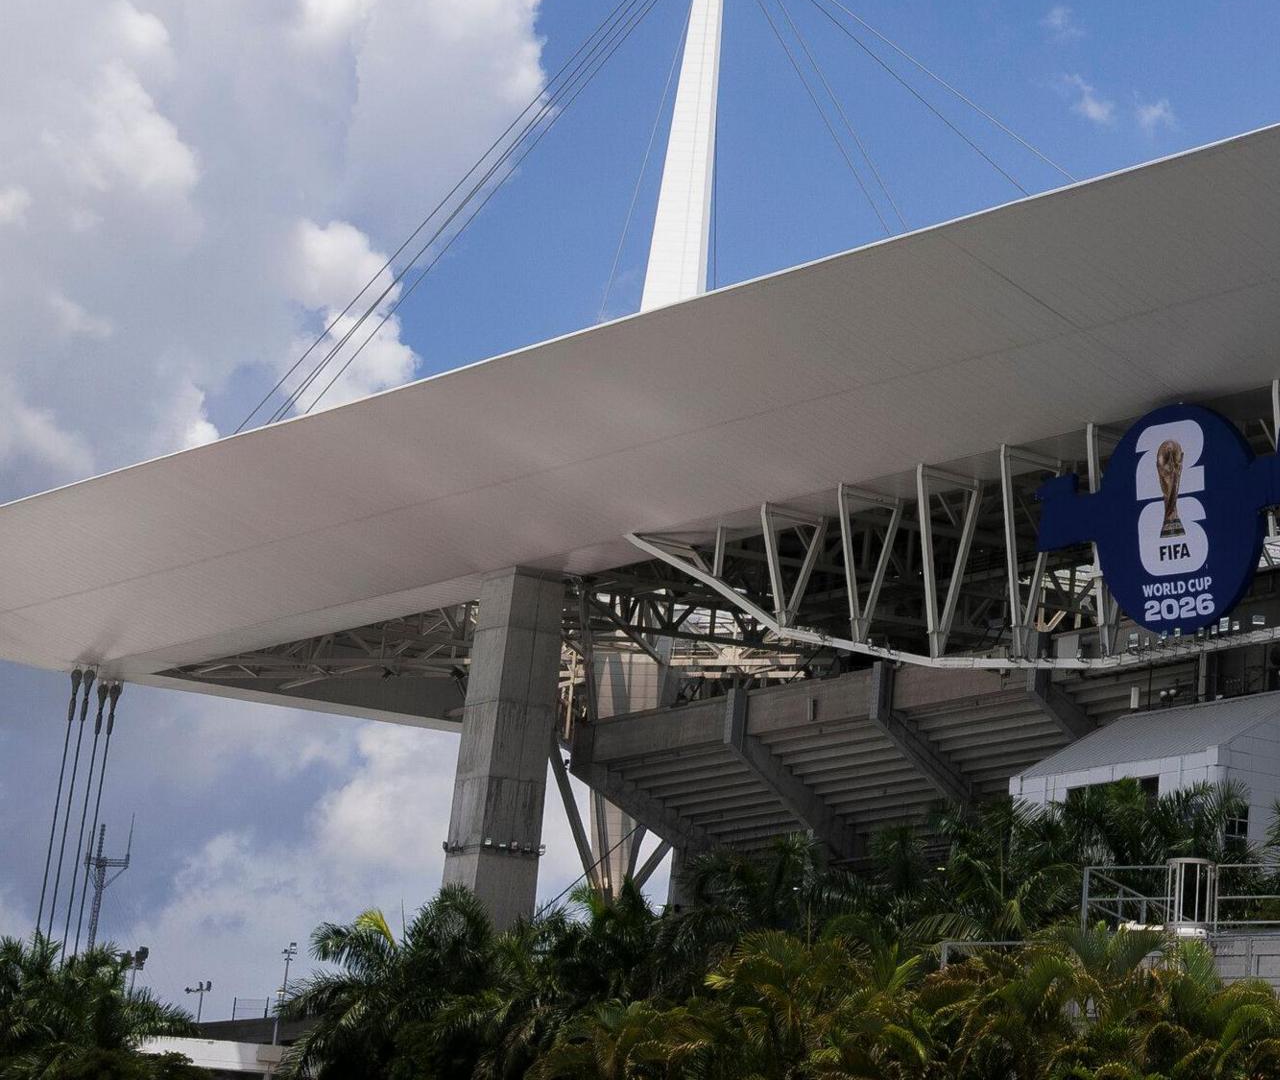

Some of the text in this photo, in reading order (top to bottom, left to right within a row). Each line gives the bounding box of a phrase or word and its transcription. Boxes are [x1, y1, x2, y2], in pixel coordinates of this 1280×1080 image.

[1159, 542, 1191, 561] FIFA
[1142, 576, 1212, 597] WORLD CUP
[1144, 593, 1215, 621] 2026
